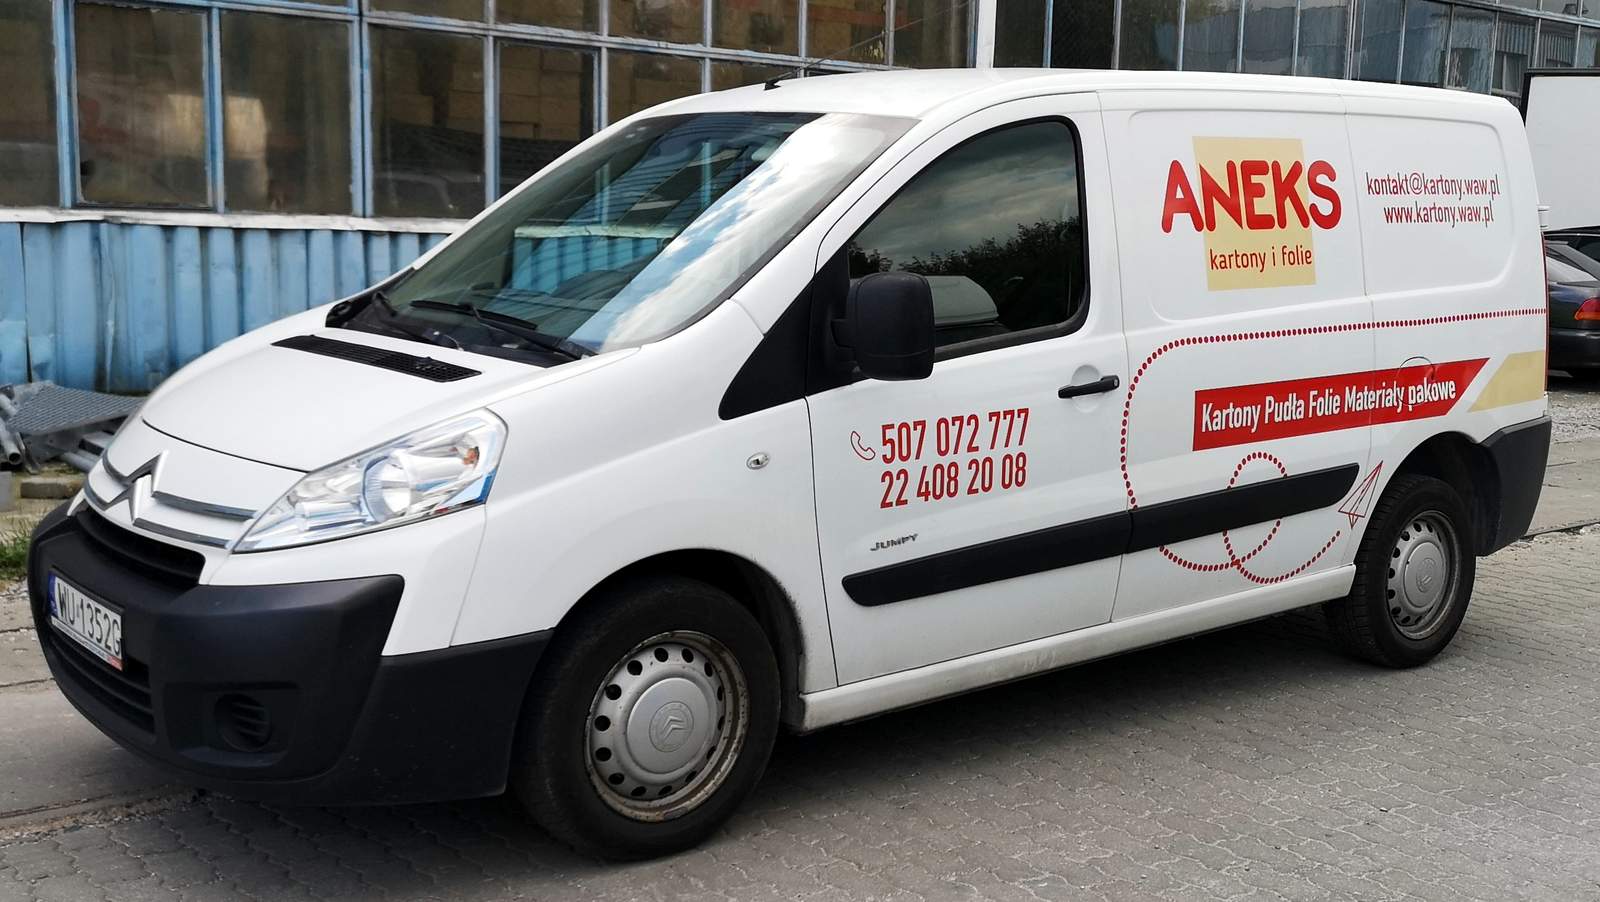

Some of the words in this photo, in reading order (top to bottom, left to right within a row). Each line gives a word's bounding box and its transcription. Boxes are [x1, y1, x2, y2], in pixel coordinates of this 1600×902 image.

[1162, 160, 1341, 233] ANEKS
[1366, 172, 1500, 200] kontakt@kartony.waw.pl
[1384, 201, 1493, 228] www.kartony.waw.pl
[1210, 249, 1266, 272] kartony
[1271, 246, 1276, 266] i
[1281, 245, 1312, 266] folie
[1202, 402, 1261, 433] Kartony
[1264, 393, 1305, 424] Pudła
[1308, 388, 1341, 418] Folie
[1408, 377, 1456, 411] pakowe
[881, 420, 926, 464] 507
[936, 414, 979, 456] 072
[988, 408, 1029, 450] 777
[880, 469, 909, 509] 22
[916, 462, 959, 502] 408
[967, 457, 993, 495] 20
[1001, 452, 1027, 489] 08
[869, 533, 919, 551] JUMPY
